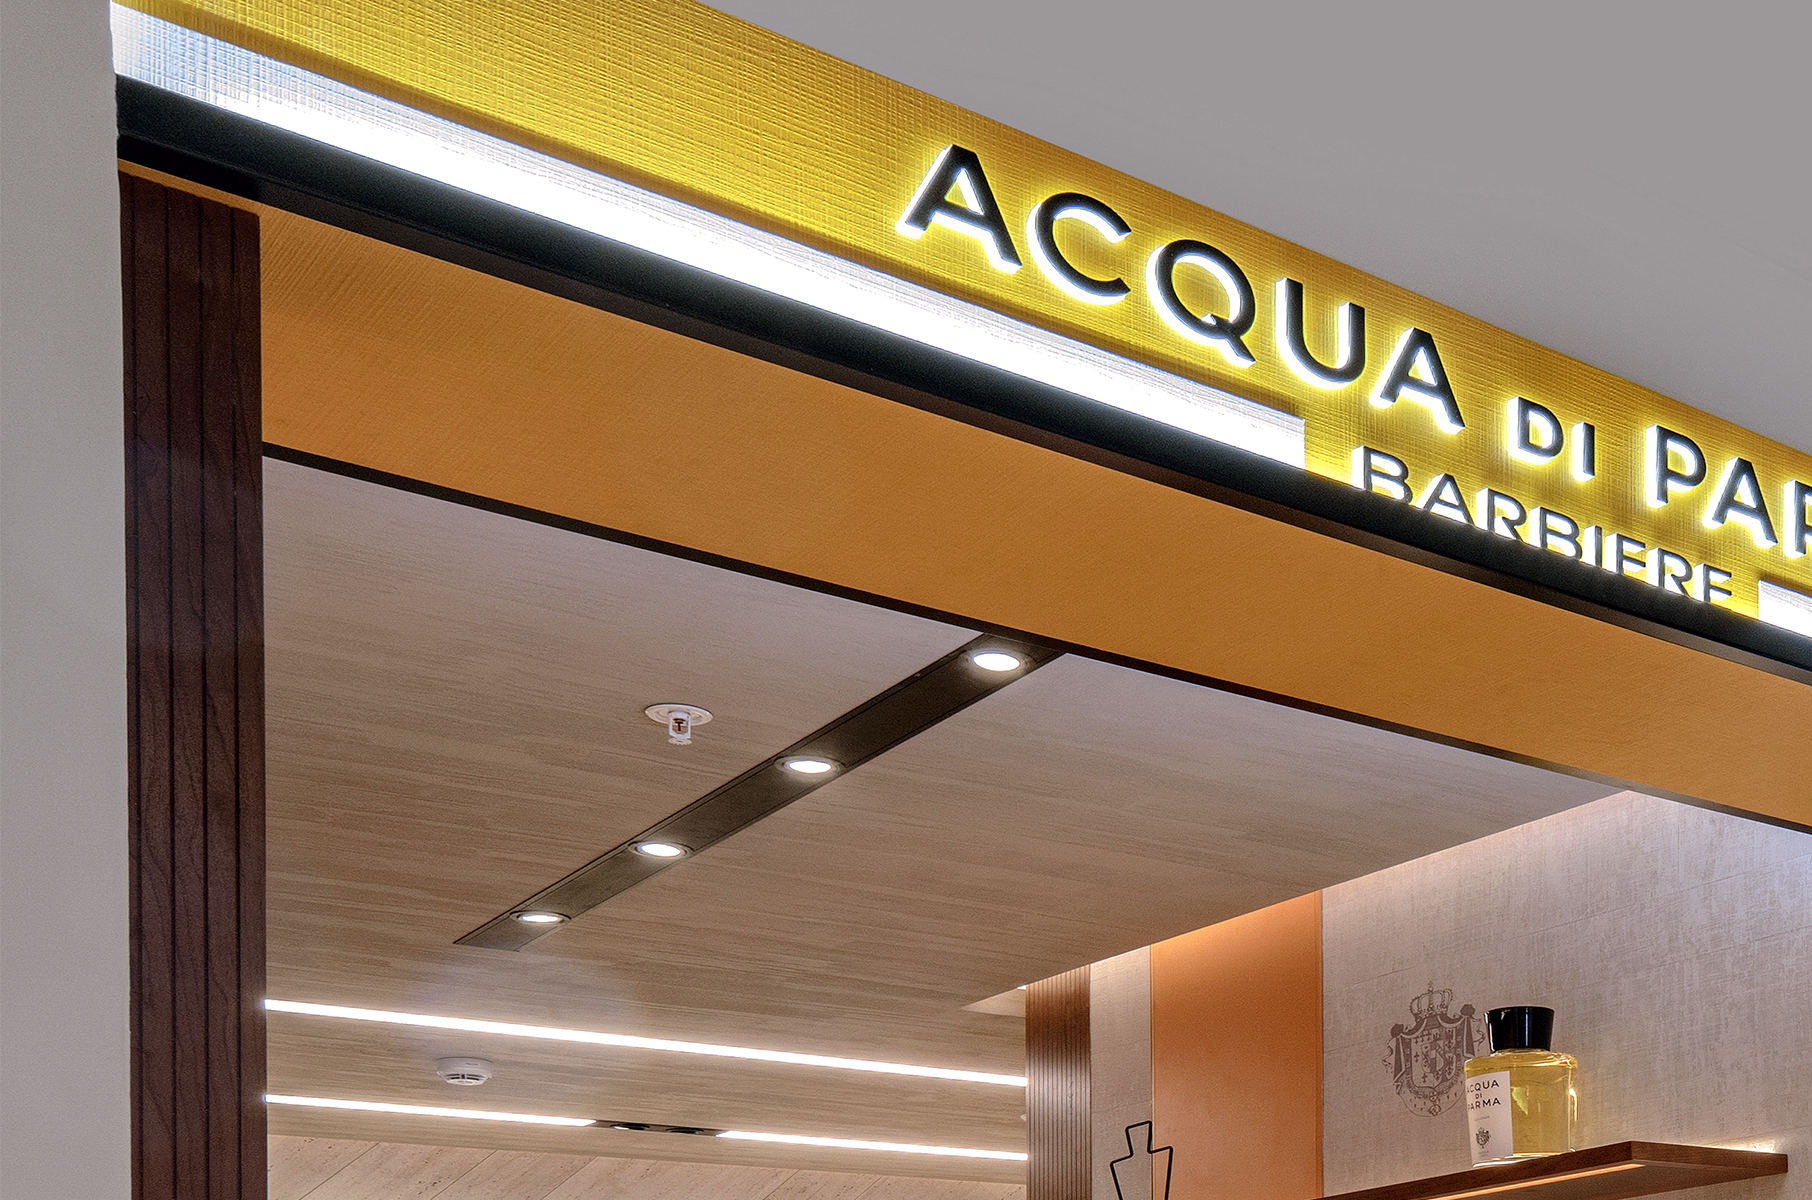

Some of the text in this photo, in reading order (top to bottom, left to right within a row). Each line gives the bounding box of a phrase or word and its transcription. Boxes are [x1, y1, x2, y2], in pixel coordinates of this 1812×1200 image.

[896, 144, 1466, 436] ACQUA
[1508, 396, 1595, 481] DI
[1351, 445, 1733, 602] BARBIERE
[1467, 1080, 1499, 1092] ACQUA
